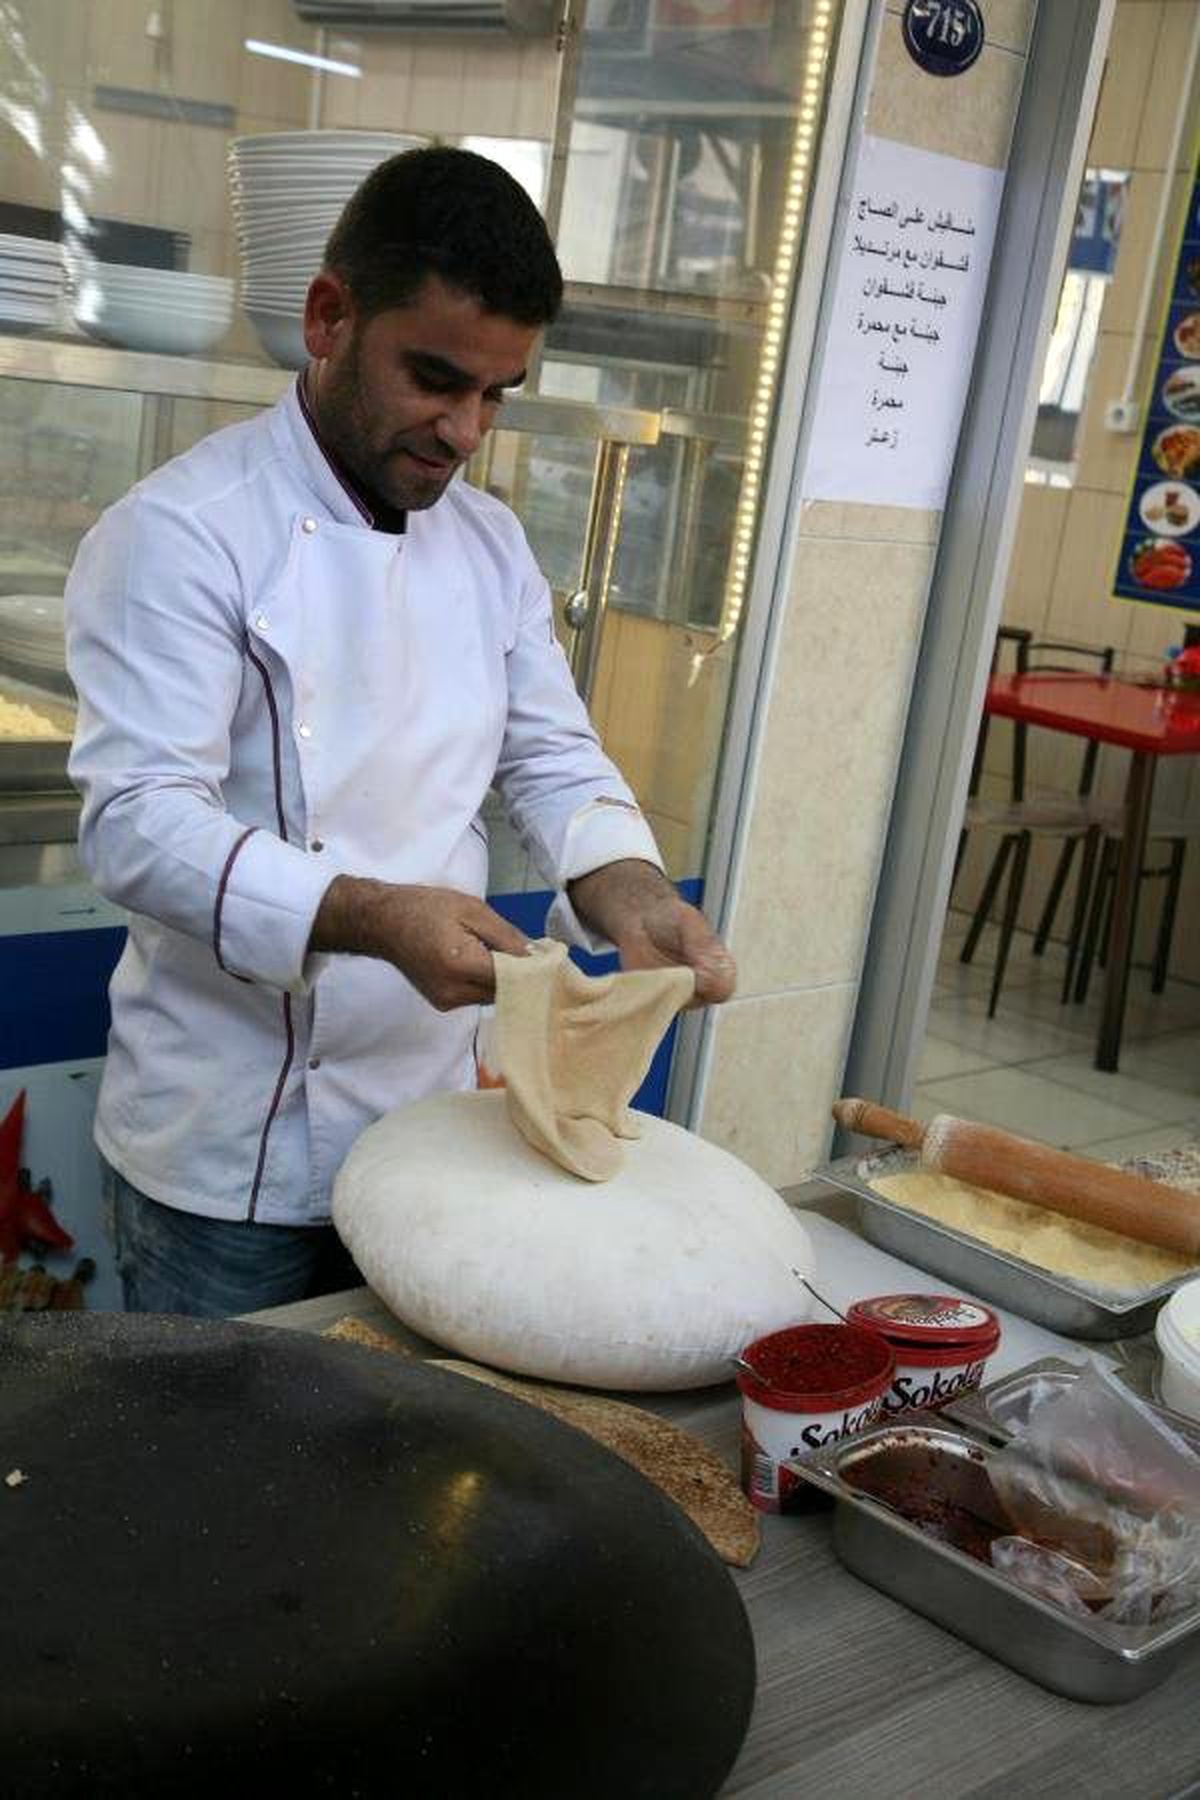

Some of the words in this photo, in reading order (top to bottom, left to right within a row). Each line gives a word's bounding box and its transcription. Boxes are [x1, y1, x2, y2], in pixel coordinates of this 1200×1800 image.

[926, 1, 966, 47] 715
[898, 207, 925, 229] على
[902, 249, 917, 269] مع
[917, 281, 947, 309] جبنة
[857, 312, 891, 336] محمرة
[892, 323, 907, 343] مع
[910, 318, 941, 346] جبنة
[878, 351, 909, 379] جبنة
[871, 389, 904, 411] محمرة
[864, 427, 899, 449] زعتر
